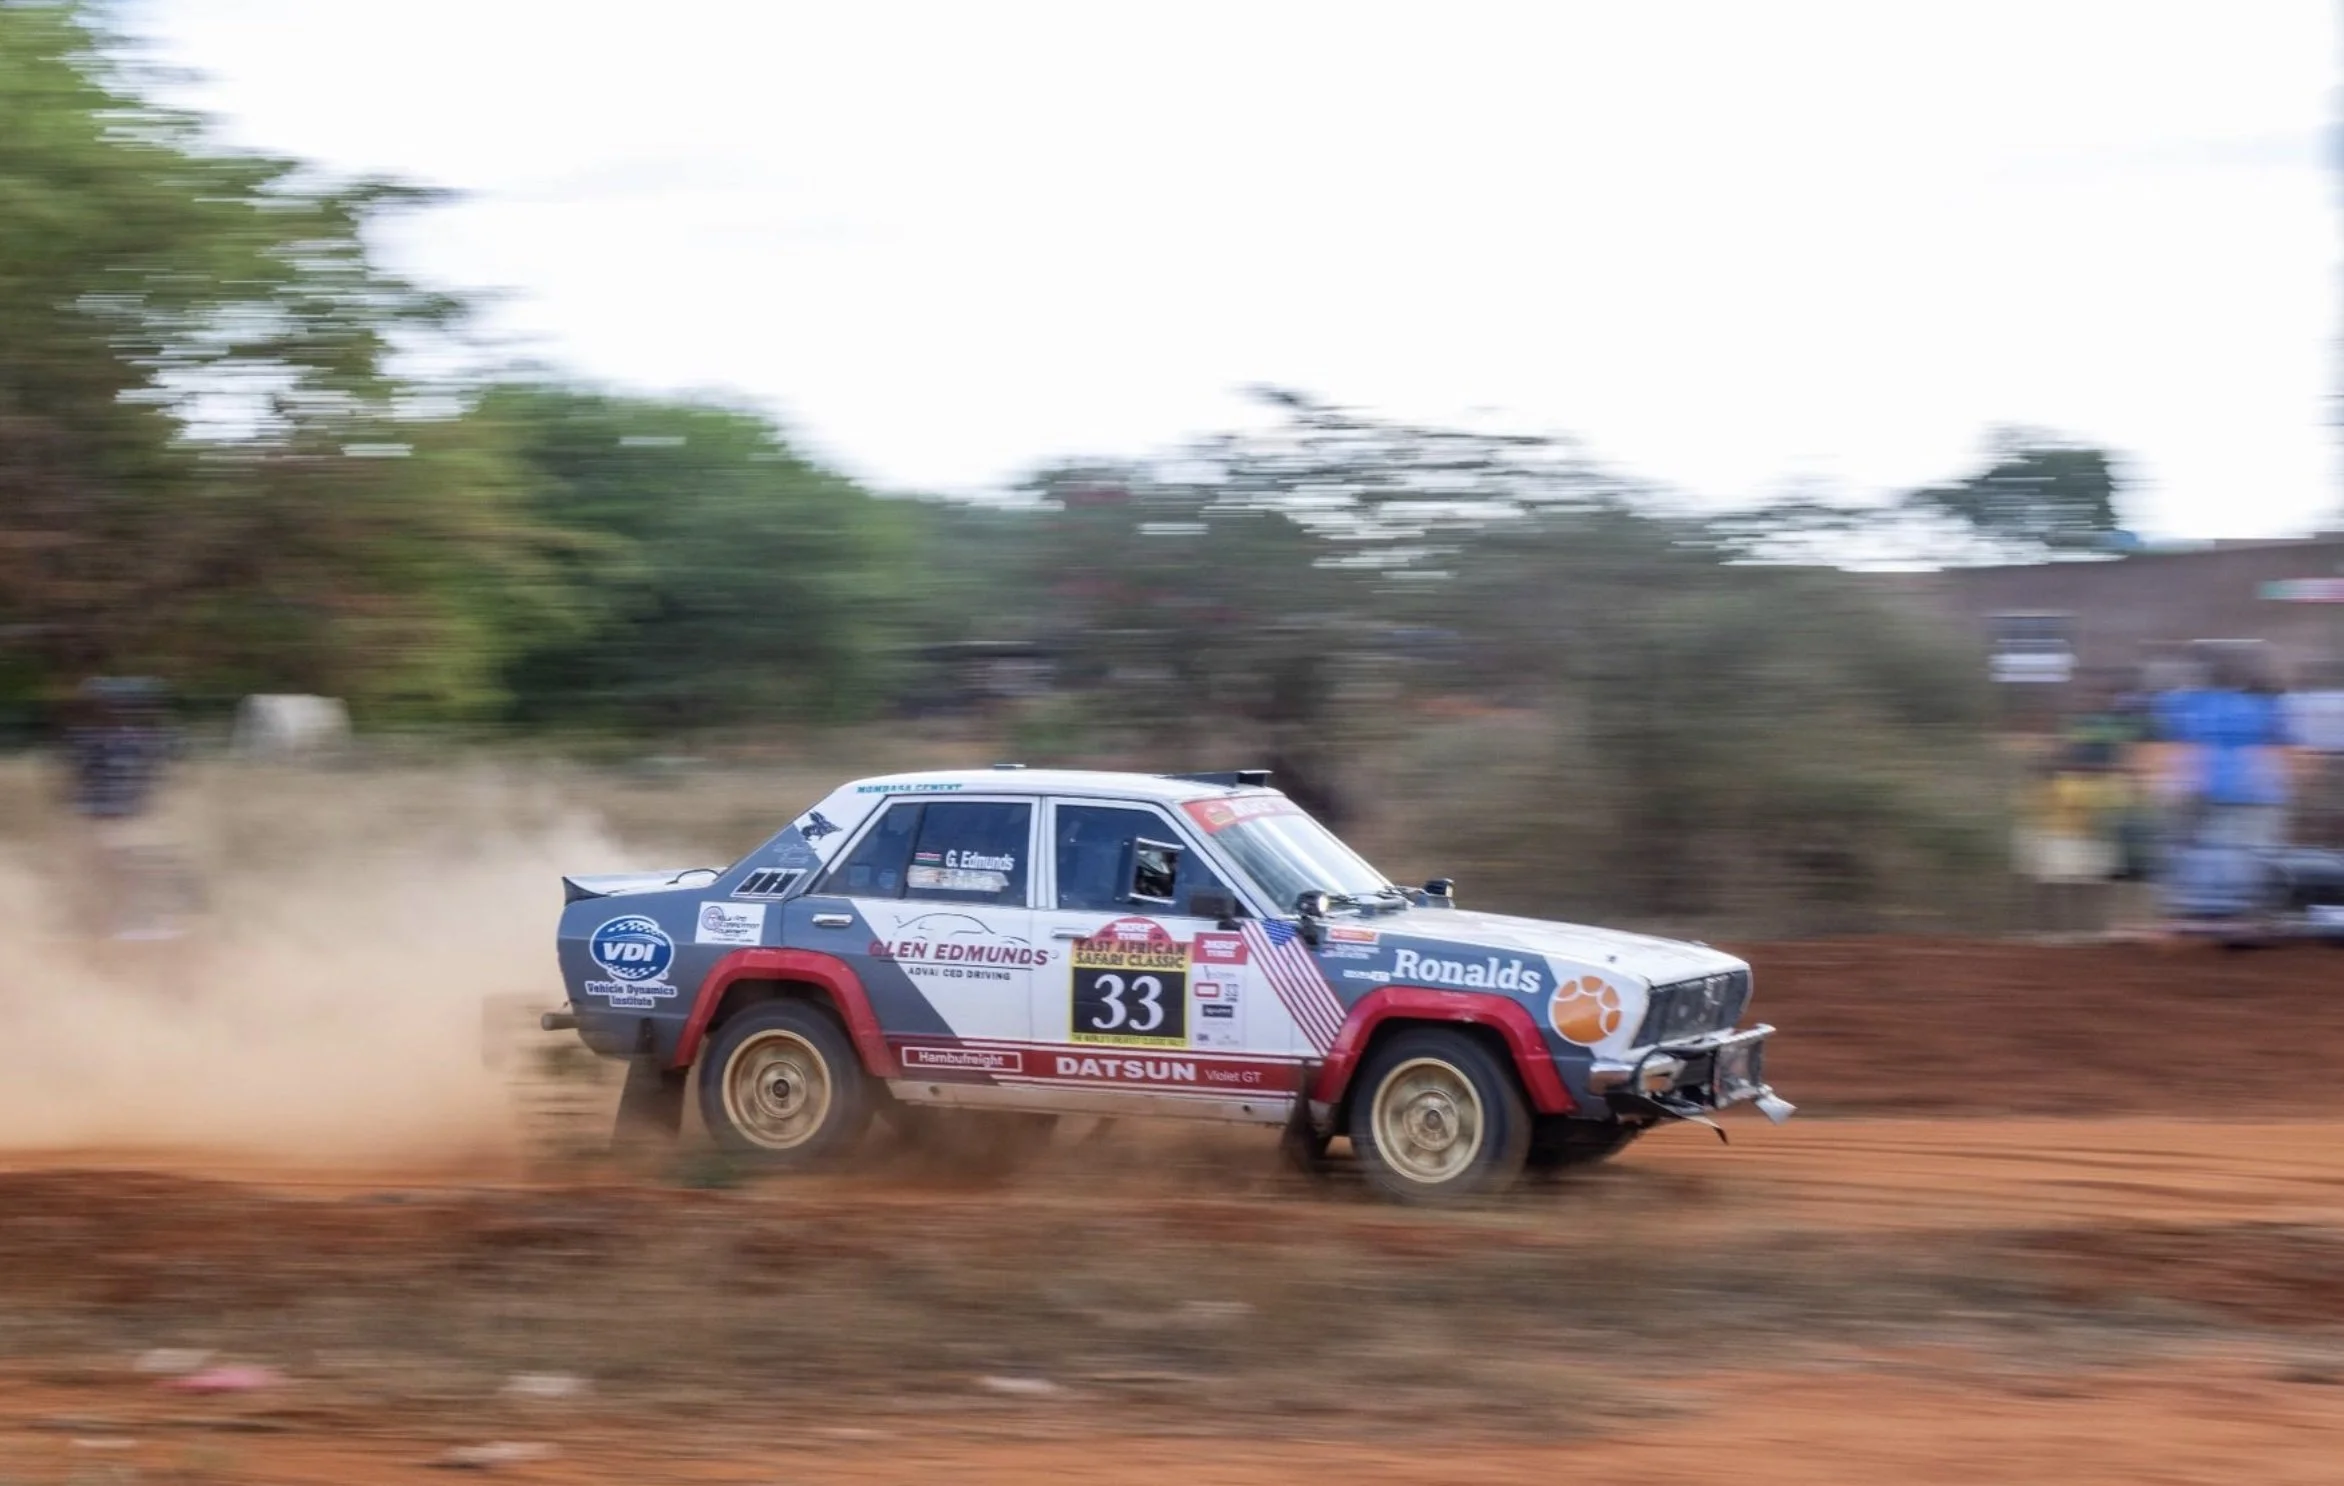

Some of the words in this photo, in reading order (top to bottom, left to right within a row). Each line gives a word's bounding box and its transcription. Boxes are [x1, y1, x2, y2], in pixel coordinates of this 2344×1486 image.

[945, 849, 958, 868] G.
[960, 850, 1015, 871] Edmunds
[603, 942, 656, 962] VDI
[868, 941, 927, 958] GLEN
[934, 944, 1049, 966] EDMUNDS
[1075, 938, 1112, 952] EAST
[1116, 940, 1187, 955] AFRICAN
[1075, 952, 1124, 966] SAFARI
[1127, 955, 1185, 969] CLASSIC
[907, 967, 964, 978] ADVACED
[966, 970, 1011, 981] DRIVING
[1391, 948, 1542, 994] Ronalds
[587, 983, 625, 994] Vehicle
[627, 984, 675, 996] Dynamics
[612, 995, 653, 1006] Institute
[1091, 973, 1164, 1031] 33
[918, 1052, 1004, 1068] Hambufreight
[1056, 1056, 1197, 1081] DATSUN
[1204, 1069, 1240, 1081] Violet
[1241, 1070, 1263, 1083] GT
